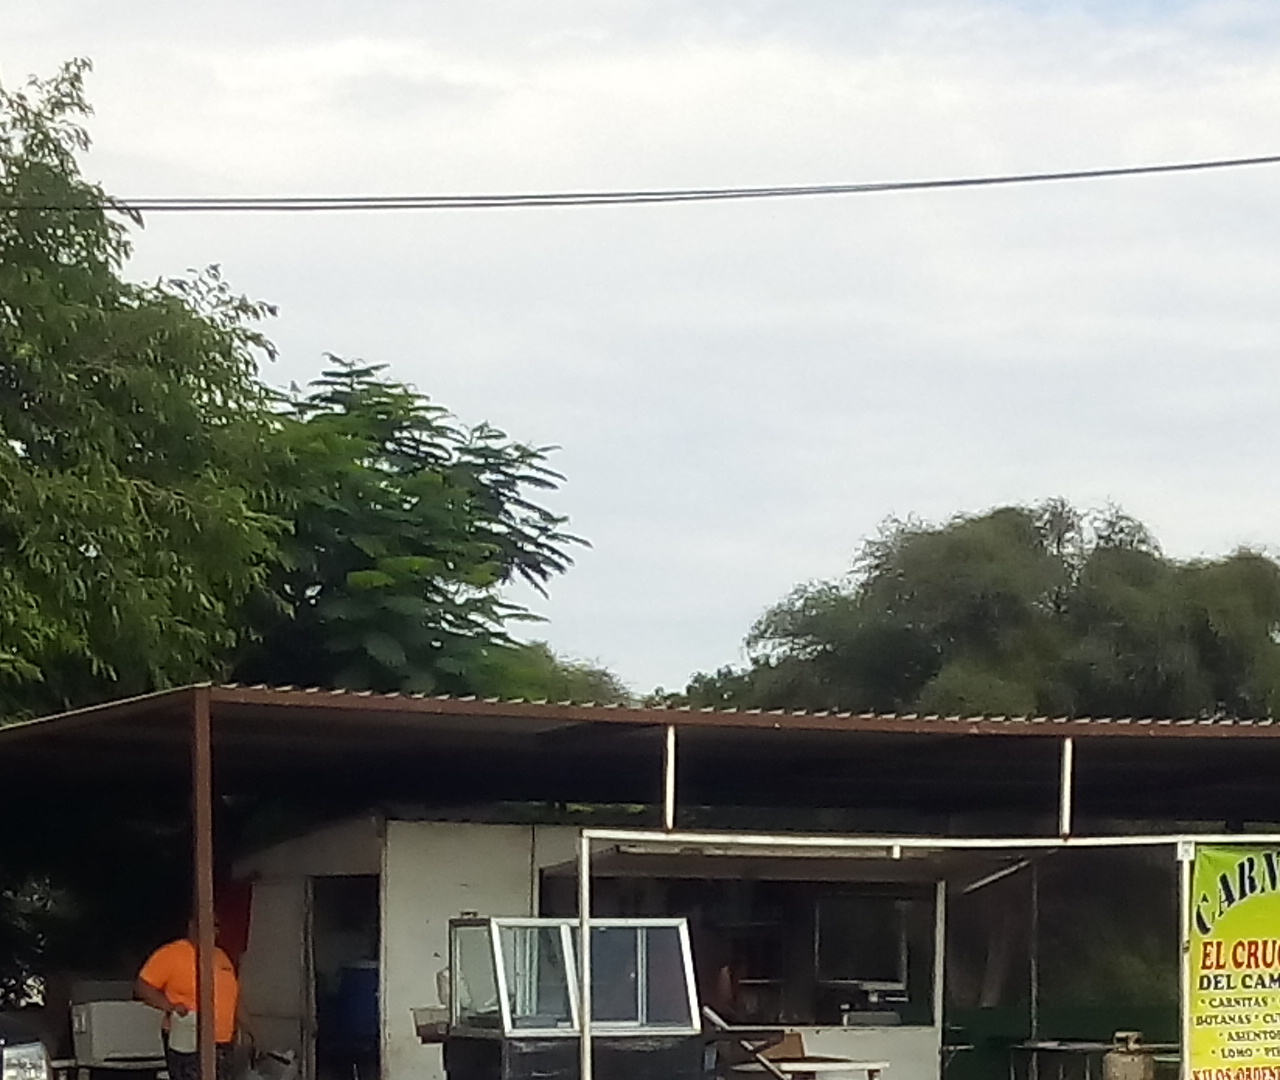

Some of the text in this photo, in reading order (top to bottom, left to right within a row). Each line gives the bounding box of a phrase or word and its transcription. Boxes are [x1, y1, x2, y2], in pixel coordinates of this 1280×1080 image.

[1200, 940, 1227, 970] EL
[1198, 974, 1237, 990] DEL
[1208, 996, 1268, 1008] CARNITAS
